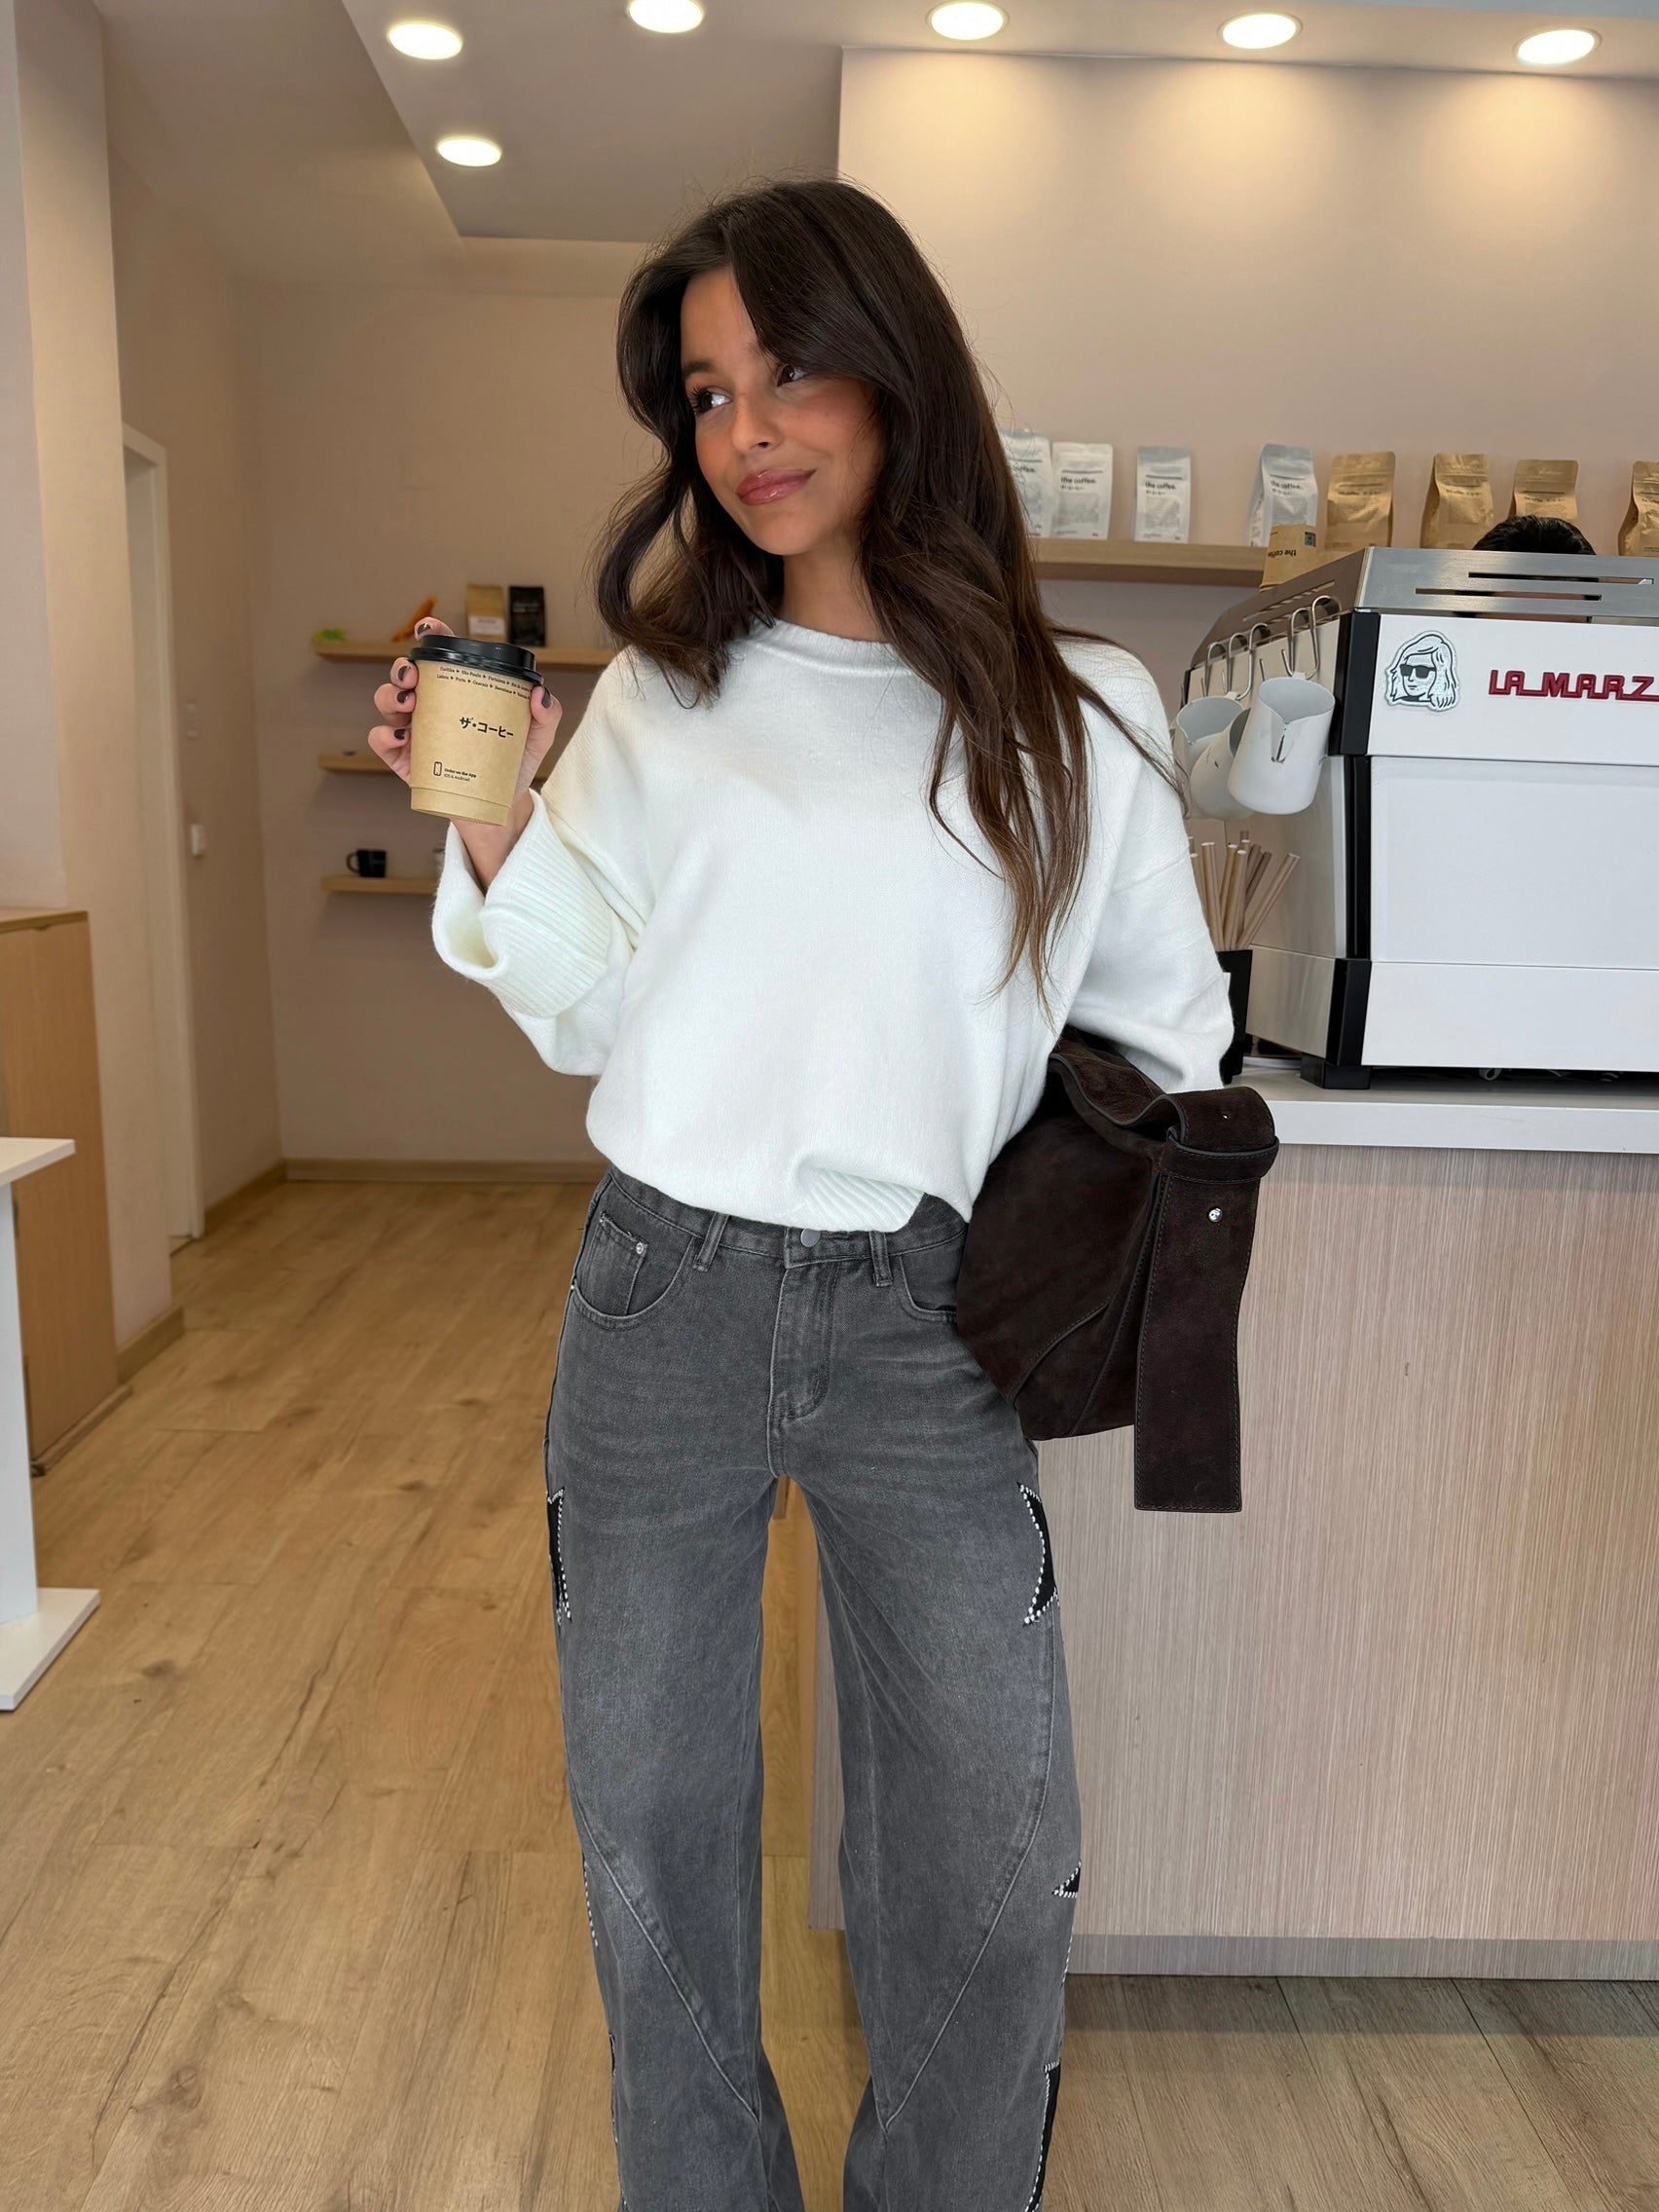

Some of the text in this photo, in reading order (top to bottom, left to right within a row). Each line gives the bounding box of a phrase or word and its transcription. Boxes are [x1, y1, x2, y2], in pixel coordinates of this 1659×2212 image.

[1489, 669, 1526, 696] LA
[460, 717, 514, 738] ザ・コーヒー
